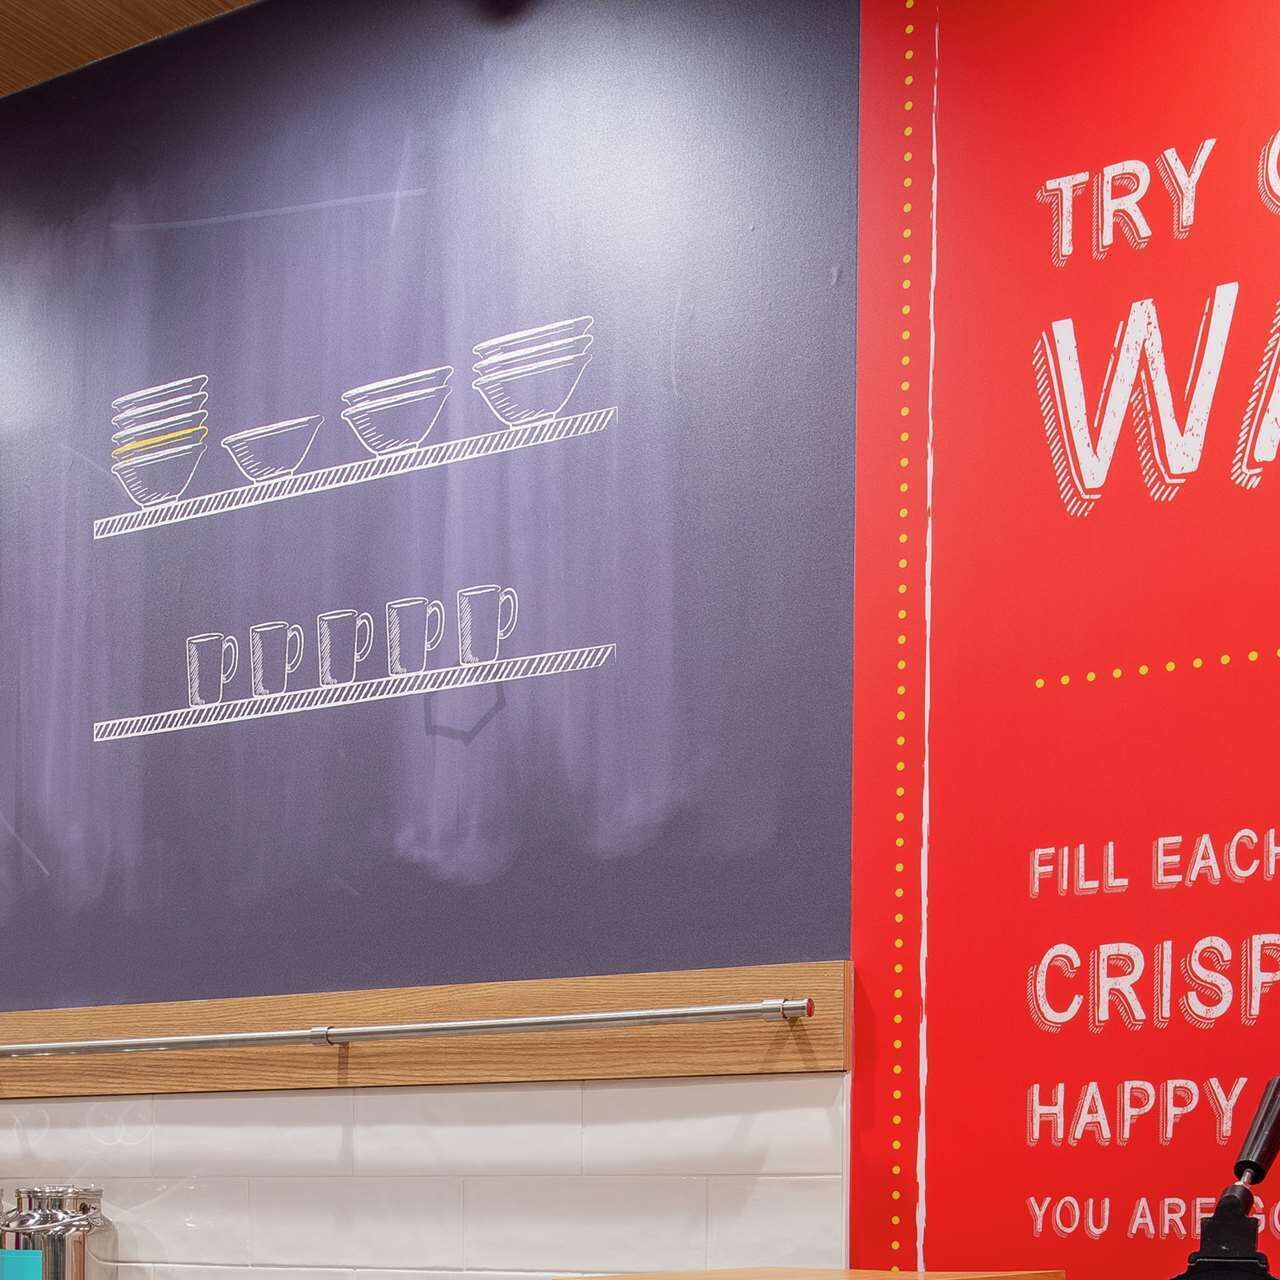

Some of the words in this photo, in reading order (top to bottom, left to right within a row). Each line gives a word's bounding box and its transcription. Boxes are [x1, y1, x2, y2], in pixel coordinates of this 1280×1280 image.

[1037, 139, 1215, 266] TRY
[1029, 841, 1128, 898] FILL
[1027, 1077, 1248, 1147] HAPPY
[1027, 1196, 1110, 1239] YOU
[1127, 1197, 1216, 1239] ARE
